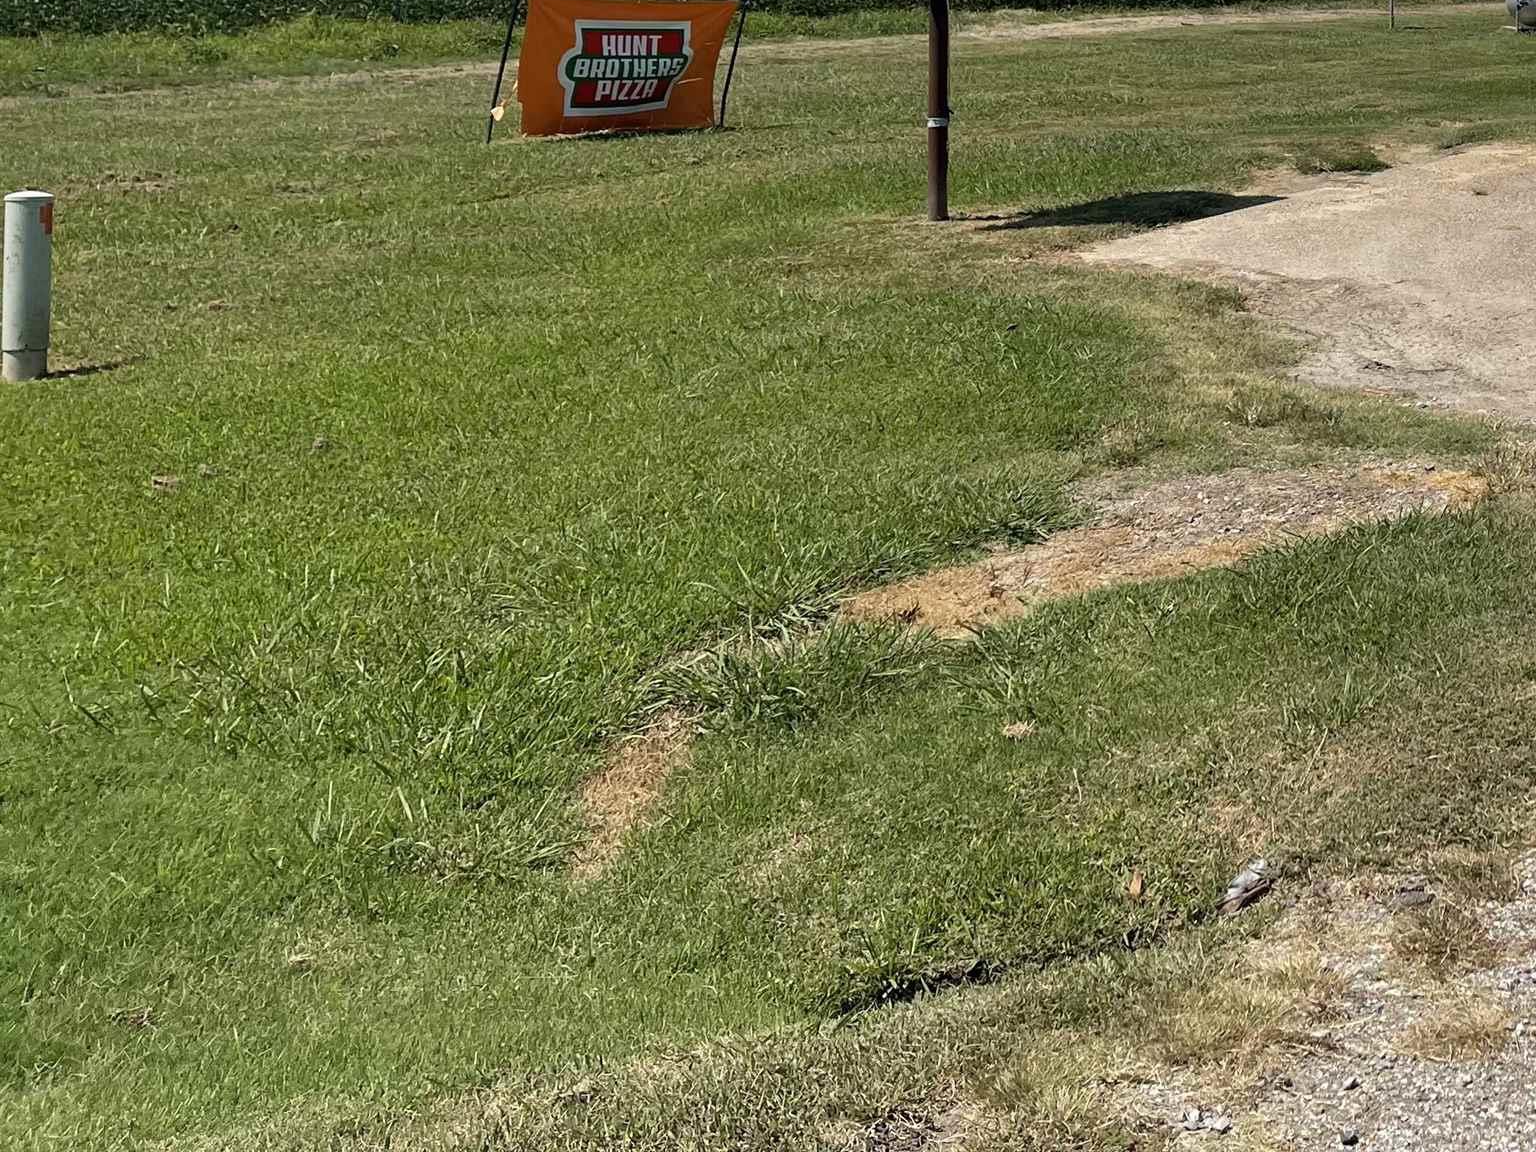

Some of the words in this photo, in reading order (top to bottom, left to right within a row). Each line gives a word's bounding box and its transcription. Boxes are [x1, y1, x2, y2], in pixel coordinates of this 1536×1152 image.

[601, 34, 662, 57] HUNT
[573, 57, 685, 78] BROTHERS
[594, 79, 658, 101] PIZZA
